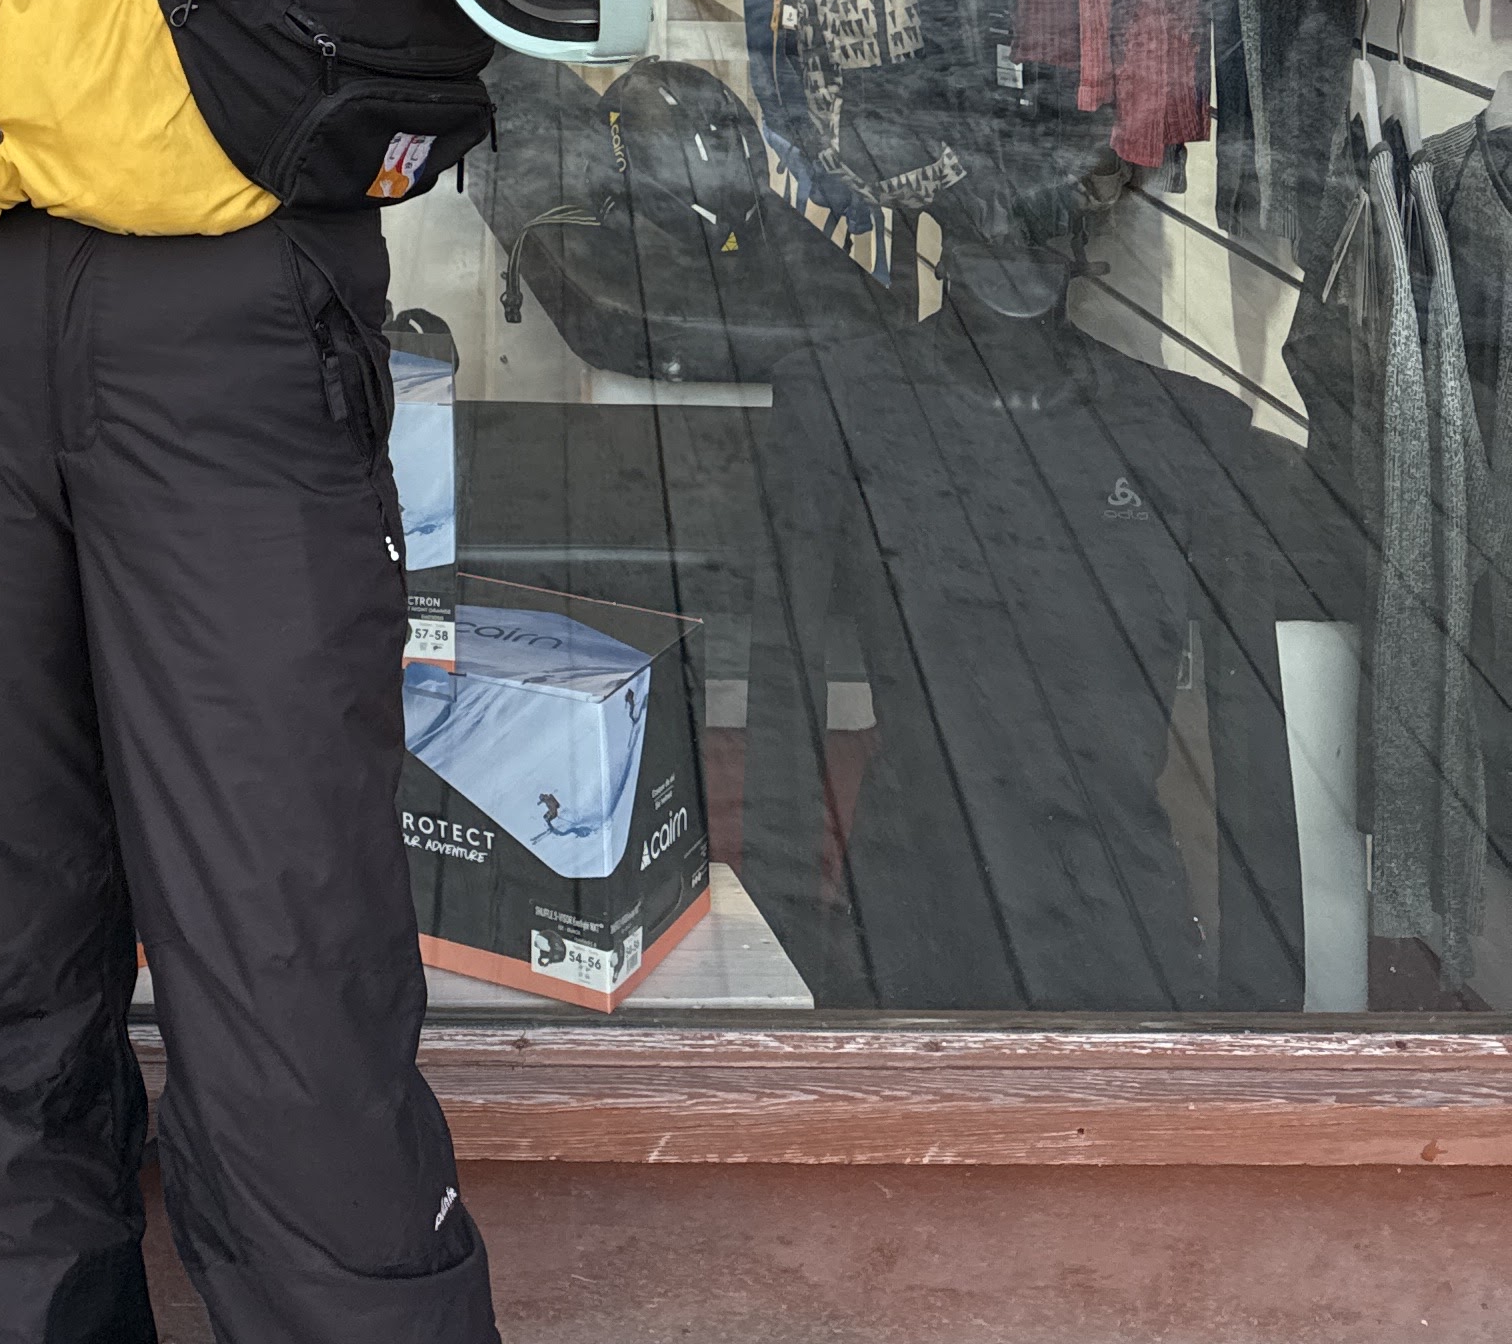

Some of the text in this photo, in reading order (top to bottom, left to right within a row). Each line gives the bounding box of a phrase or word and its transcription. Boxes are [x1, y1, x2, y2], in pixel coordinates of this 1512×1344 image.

[610, 123, 627, 173] cairn
[414, 627, 449, 641] 57-58
[650, 806, 688, 860] cairn
[424, 838, 489, 863] ADVENTURE
[568, 950, 602, 970] 54-56
